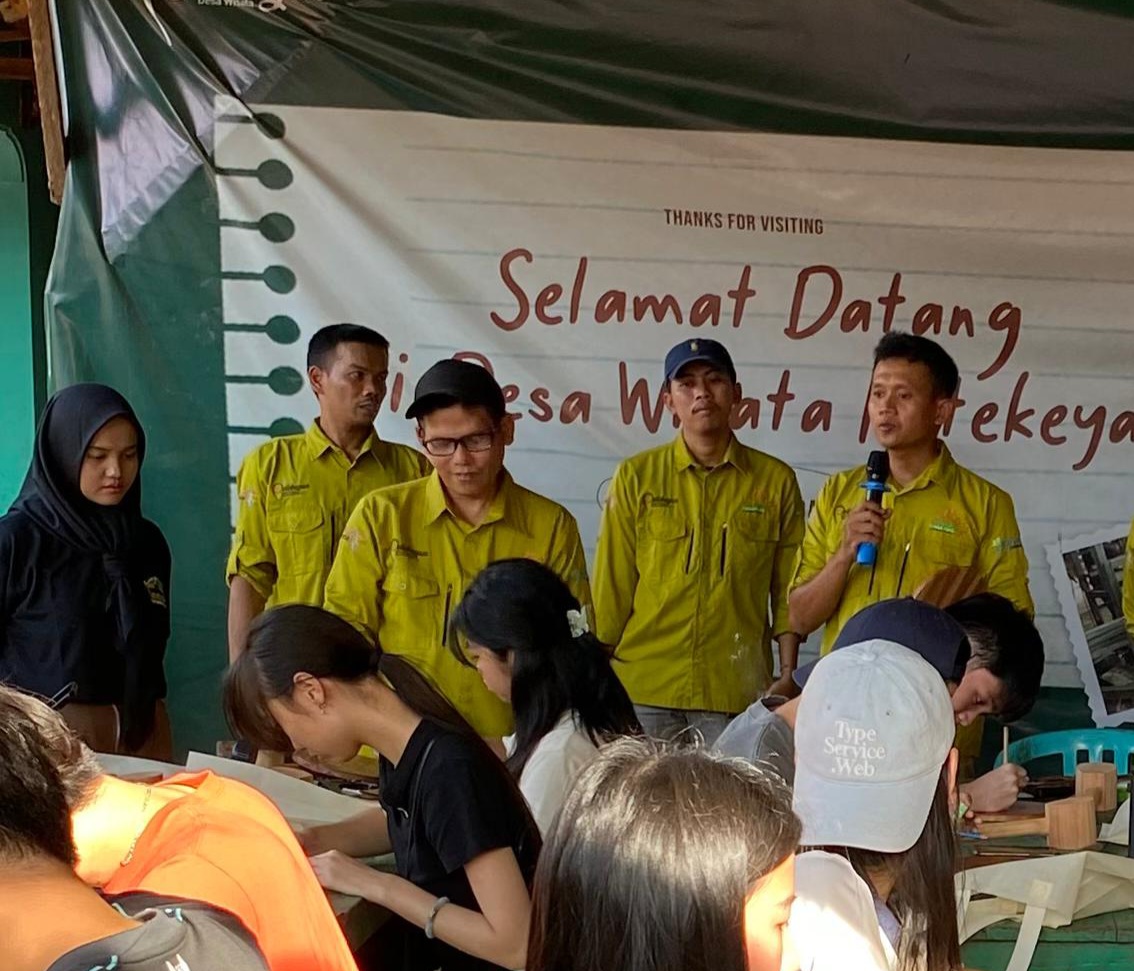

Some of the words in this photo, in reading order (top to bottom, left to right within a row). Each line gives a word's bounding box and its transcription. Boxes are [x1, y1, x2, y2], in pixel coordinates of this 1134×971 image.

[664, 208, 723, 229] THANKS
[727, 213, 756, 231] FOR
[760, 215, 824, 235] VISITING
[490, 248, 757, 331] Selamat
[783, 265, 1021, 381] Datang
[618, 360, 832, 434] Wata
[835, 720, 877, 745] Type
[823, 736, 886, 760] Service
[831, 756, 876, 777] .Web
